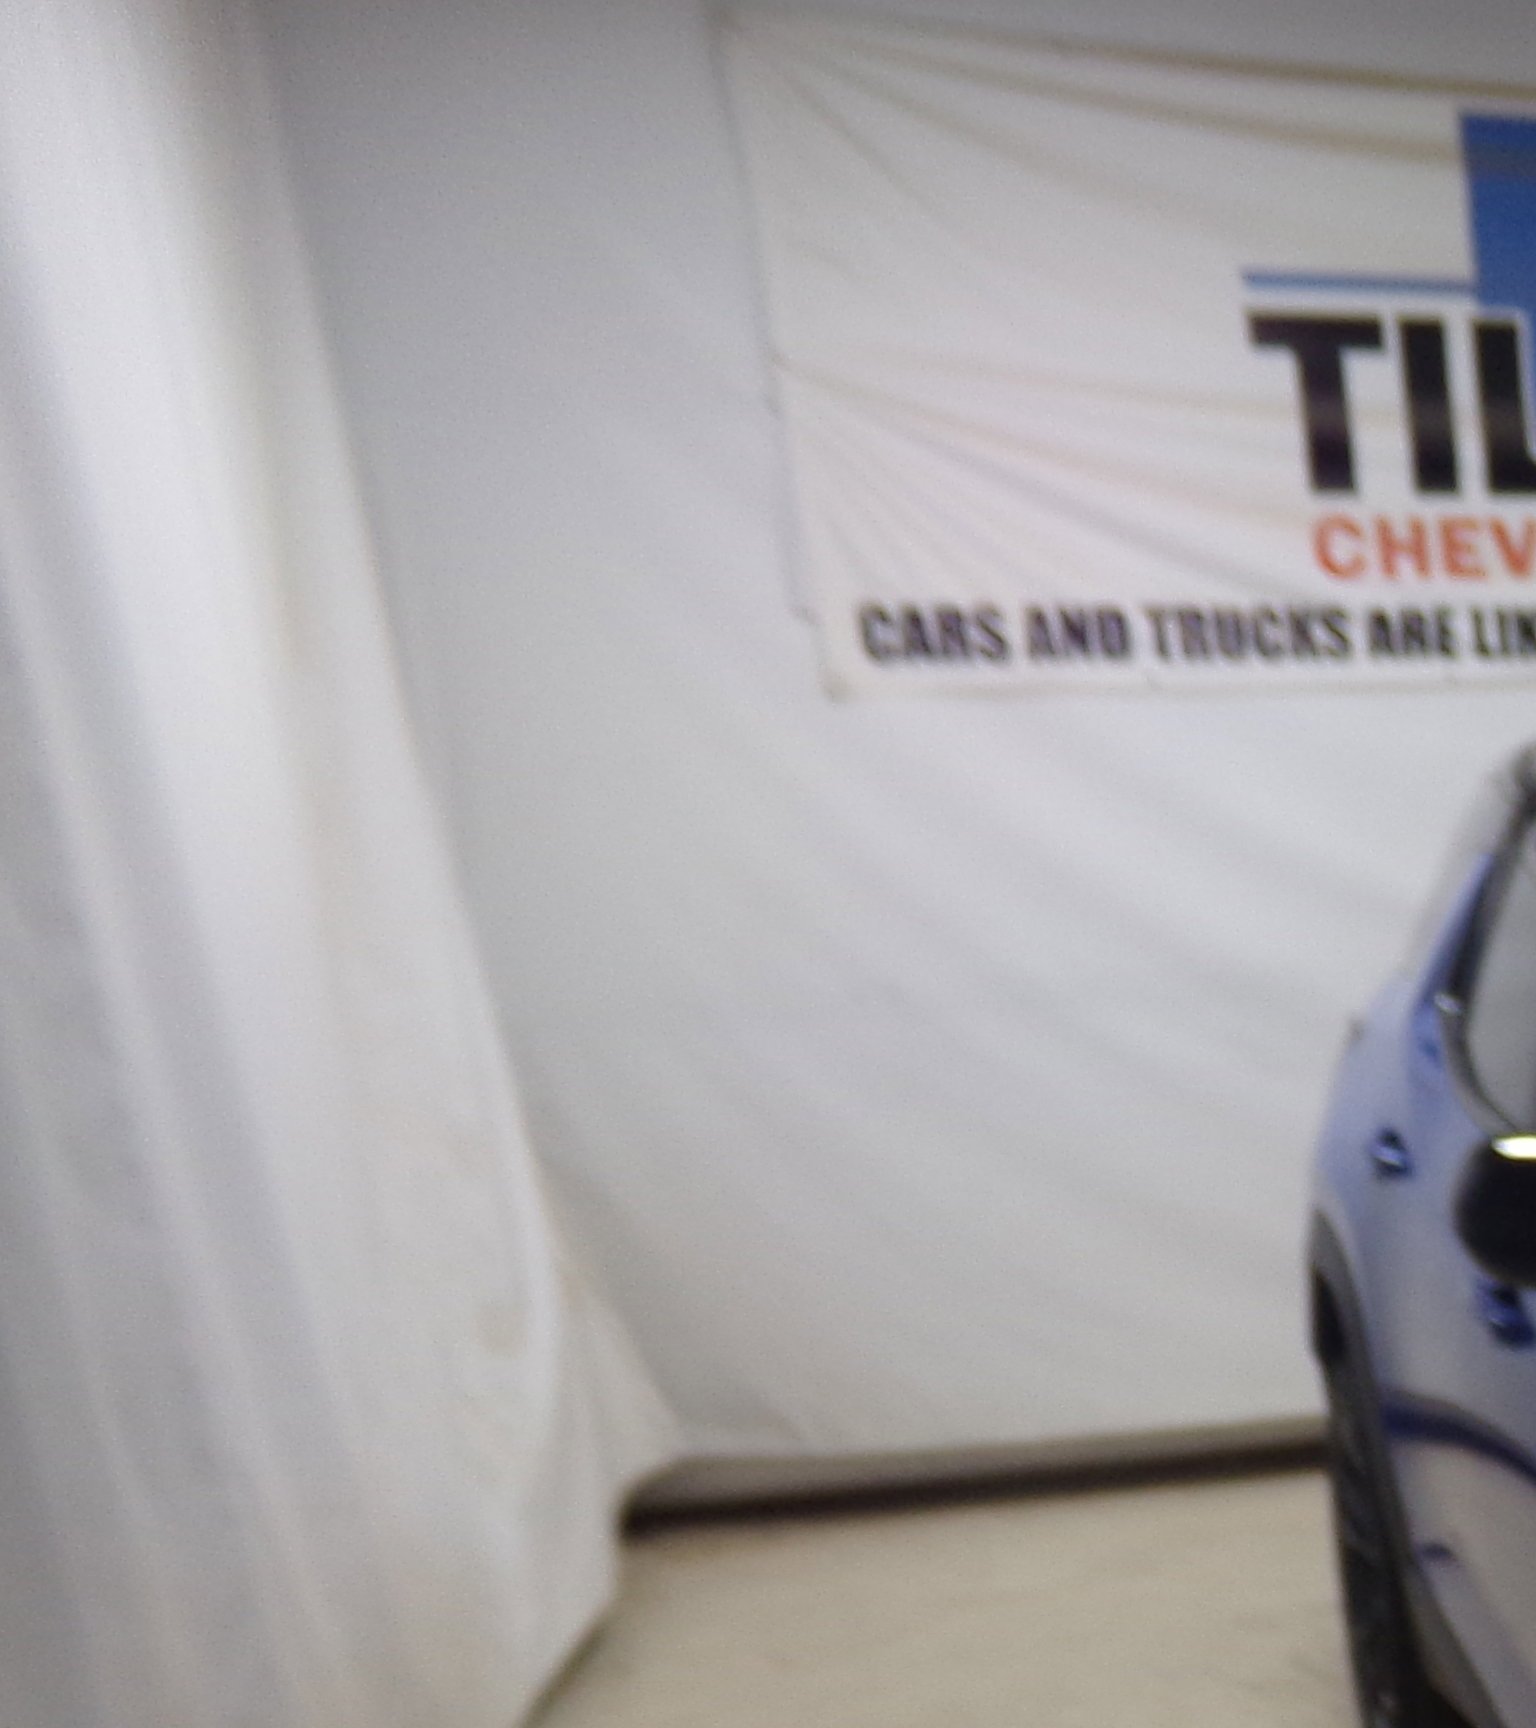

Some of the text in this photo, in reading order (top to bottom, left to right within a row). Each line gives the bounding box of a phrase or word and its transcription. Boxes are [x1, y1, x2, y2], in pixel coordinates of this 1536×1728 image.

[858, 602, 1010, 662] CARS
[1024, 602, 1132, 660] AND
[1142, 602, 1354, 660] TRUCKS
[1366, 604, 1456, 658] ARE
